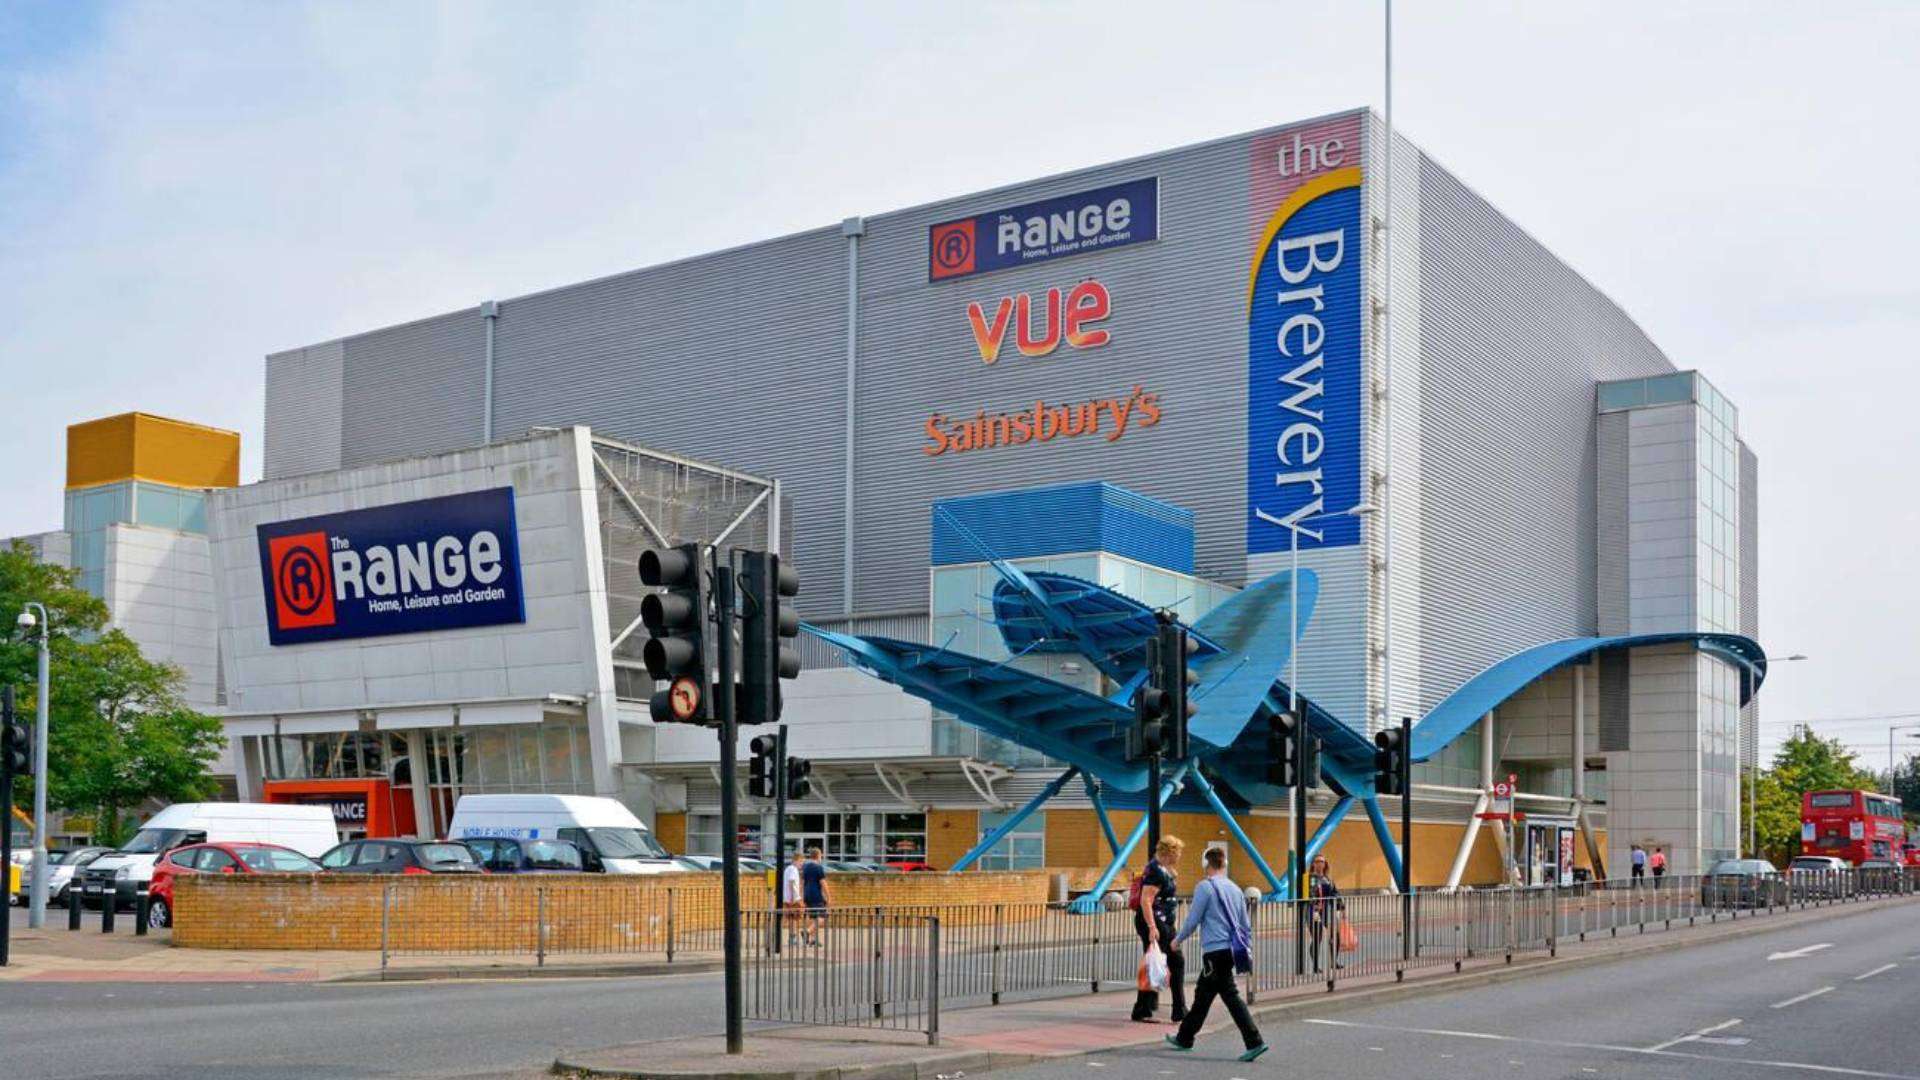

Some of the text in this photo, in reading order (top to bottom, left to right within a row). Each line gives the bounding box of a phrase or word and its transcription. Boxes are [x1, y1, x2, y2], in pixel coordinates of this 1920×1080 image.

[1276, 133, 1345, 177] the
[1051, 241, 1080, 254] Leisure
[1081, 236, 1098, 248] and
[1099, 231, 1132, 245] Garden
[1256, 227, 1345, 543] Brewery
[923, 384, 1162, 456] Sainsbury's
[330, 535, 350, 550] The
[368, 586, 506, 613] Home, Leisure and Garden
[333, 802, 365, 819] ANCE
